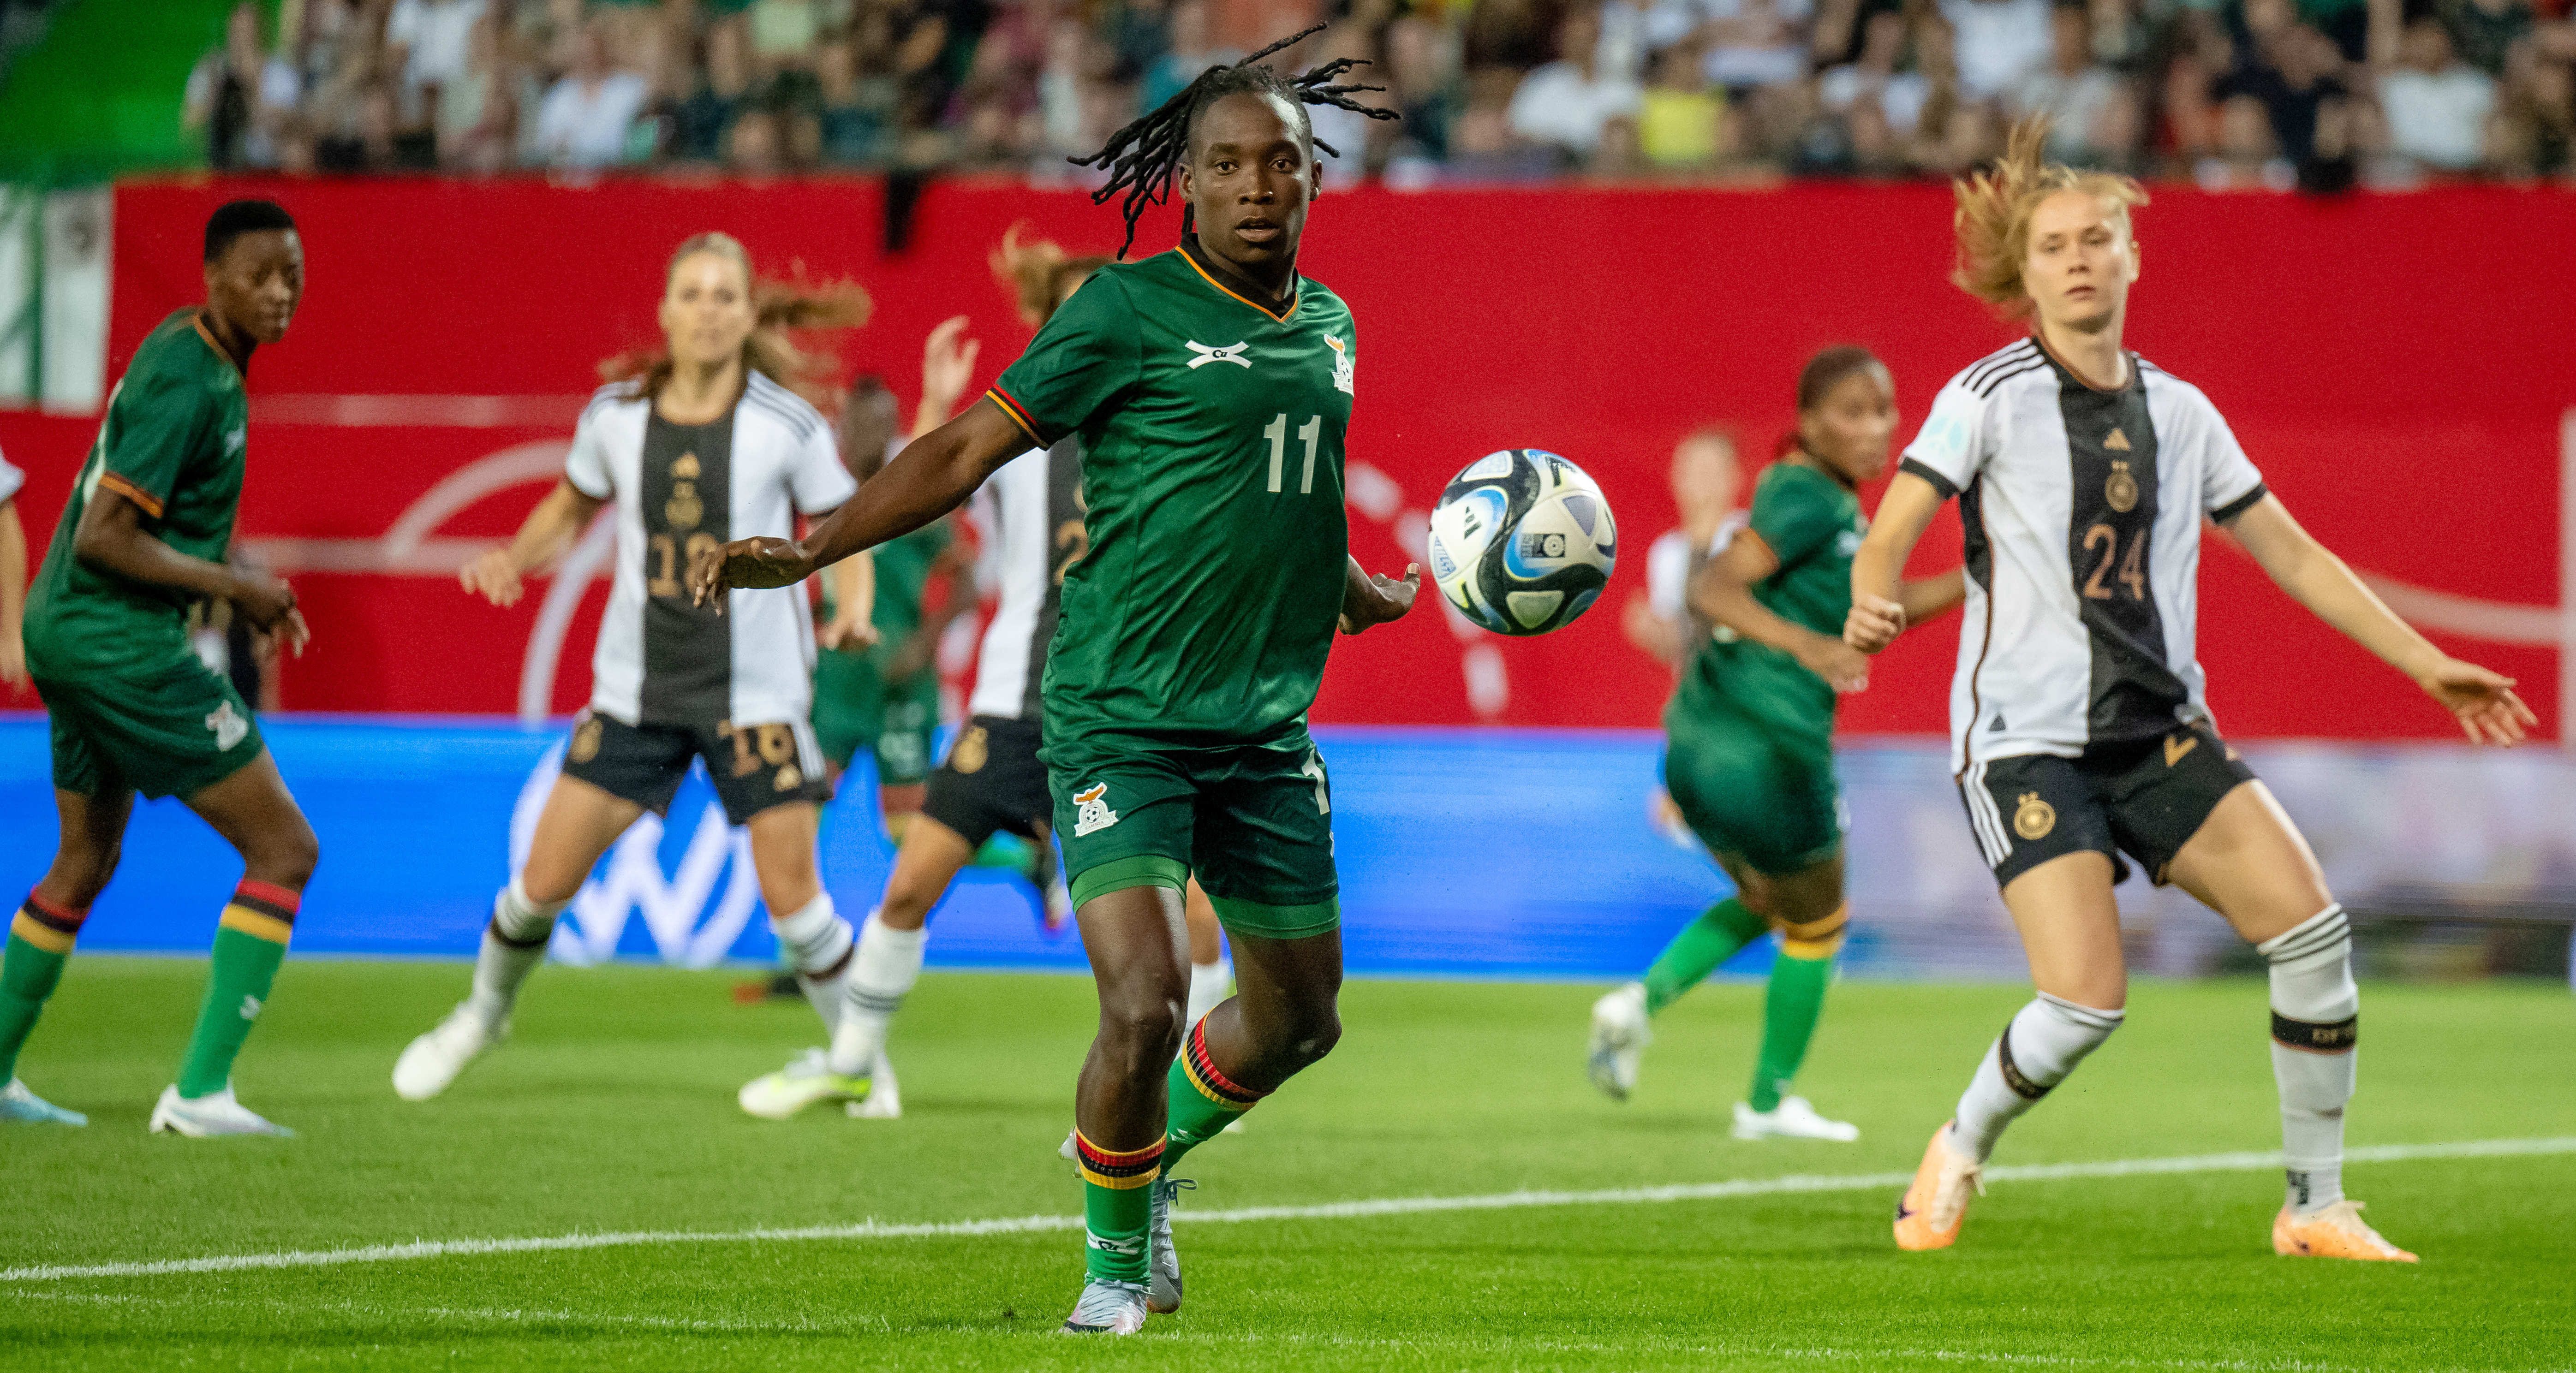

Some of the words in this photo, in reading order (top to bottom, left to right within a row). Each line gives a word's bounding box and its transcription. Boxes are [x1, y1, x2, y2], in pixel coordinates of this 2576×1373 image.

[1212, 350, 1228, 358] Cu
[1264, 413, 1321, 493] 11
[2084, 524, 2145, 600] 24
